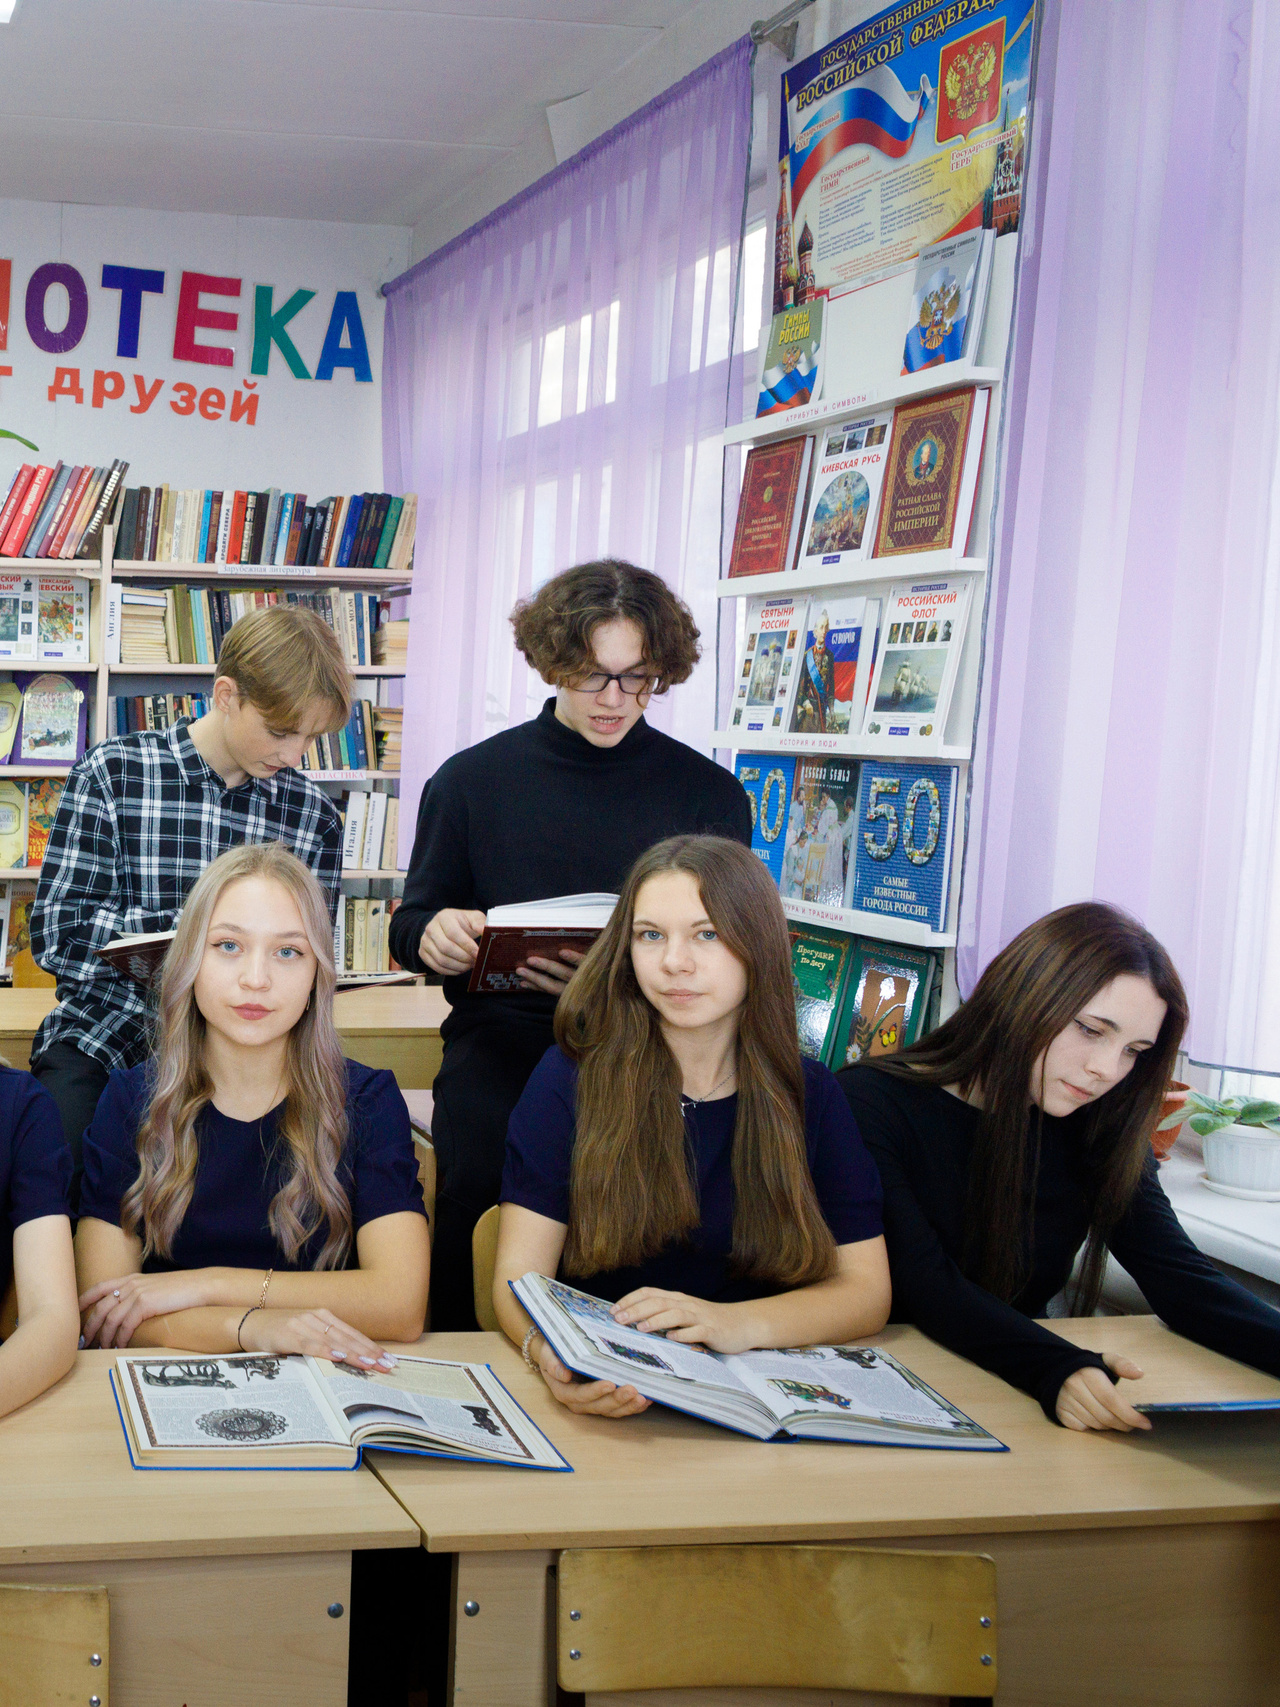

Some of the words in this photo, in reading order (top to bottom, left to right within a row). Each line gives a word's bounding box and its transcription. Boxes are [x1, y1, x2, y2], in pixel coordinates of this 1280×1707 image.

[797, 33, 903, 110] РОССИЙСКОЙ
[951, 128, 1018, 160] Государственный
[820, 155, 870, 184] Государственный
[950, 157, 972, 171] ГЕРБ
[820, 178, 840, 193] ГИМН
[778, 323, 811, 346] РОССИИ
[47, 366, 260, 426] друзей
[785, 408, 819, 423] АТРИБУТЫ
[824, 404, 828, 413] И
[831, 394, 867, 411] СИМВОЛЫ
[820, 458, 859, 474] КИЕВСКАЯ
[861, 453, 881, 465] РУСЬ
[21, 483, 41, 516] НАРОДНАЯ
[34, 466, 47, 485] РУСЬ
[897, 496, 920, 507] РАТНАЯ
[920, 492, 942, 503] СЛАВА
[895, 502, 940, 519] РОССИЙСКОЙ
[893, 515, 939, 533] ИМПЕРИИ
[220, 532, 228, 561] БРОДЯГИ
[223, 564, 267, 575] Зарубежная
[268, 566, 311, 576] литература
[897, 591, 957, 608] РОССИЙСКИЙ
[107, 600, 117, 640] Англия
[760, 606, 794, 619] СВЯТЫНИ
[911, 608, 938, 619] ФЛОТ
[760, 619, 790, 631] РОССИИ
[831, 631, 856, 646] СУВОРОВ
[779, 738, 809, 747] ИСТОРИЯ
[812, 739, 816, 747] И
[818, 740, 838, 748] ЛЮДИ
[863, 777, 942, 866] 50
[344, 819, 359, 858] Италия
[883, 875, 909, 888] САМЫЕ
[874, 886, 918, 902] ИЗВЕСТНЫЕ
[809, 908, 844, 923] ТРАДИЦИИ
[862, 896, 894, 911] ГОРОДА
[894, 901, 929, 917] РОССИИ
[796, 944, 835, 962] Прогулки
